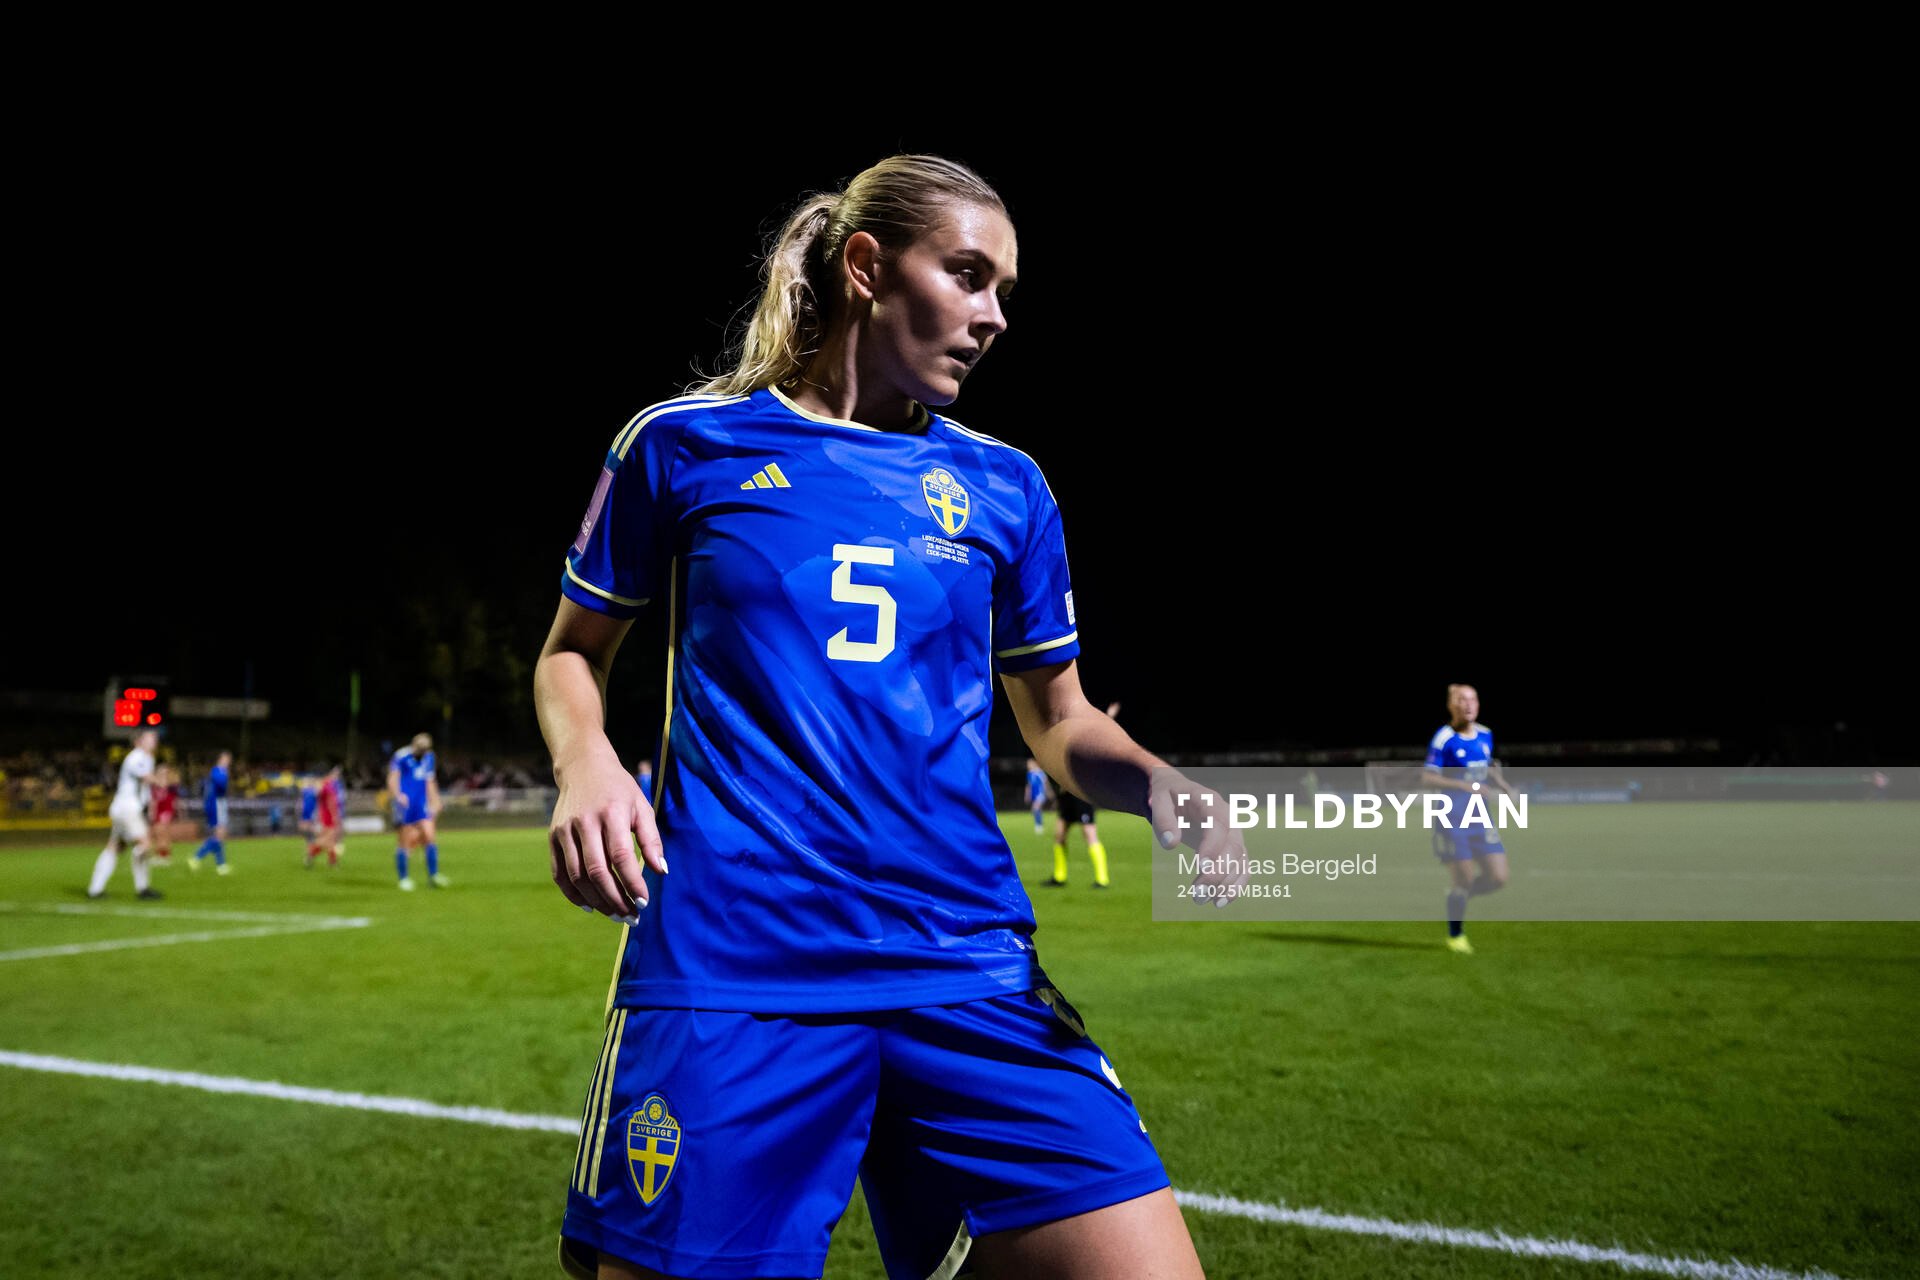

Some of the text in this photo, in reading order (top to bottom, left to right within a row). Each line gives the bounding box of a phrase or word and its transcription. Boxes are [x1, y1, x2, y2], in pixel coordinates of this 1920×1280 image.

[929, 483, 961, 497] SVERIGE
[827, 543, 897, 663] 5
[636, 1125, 672, 1137] SVERIGE
